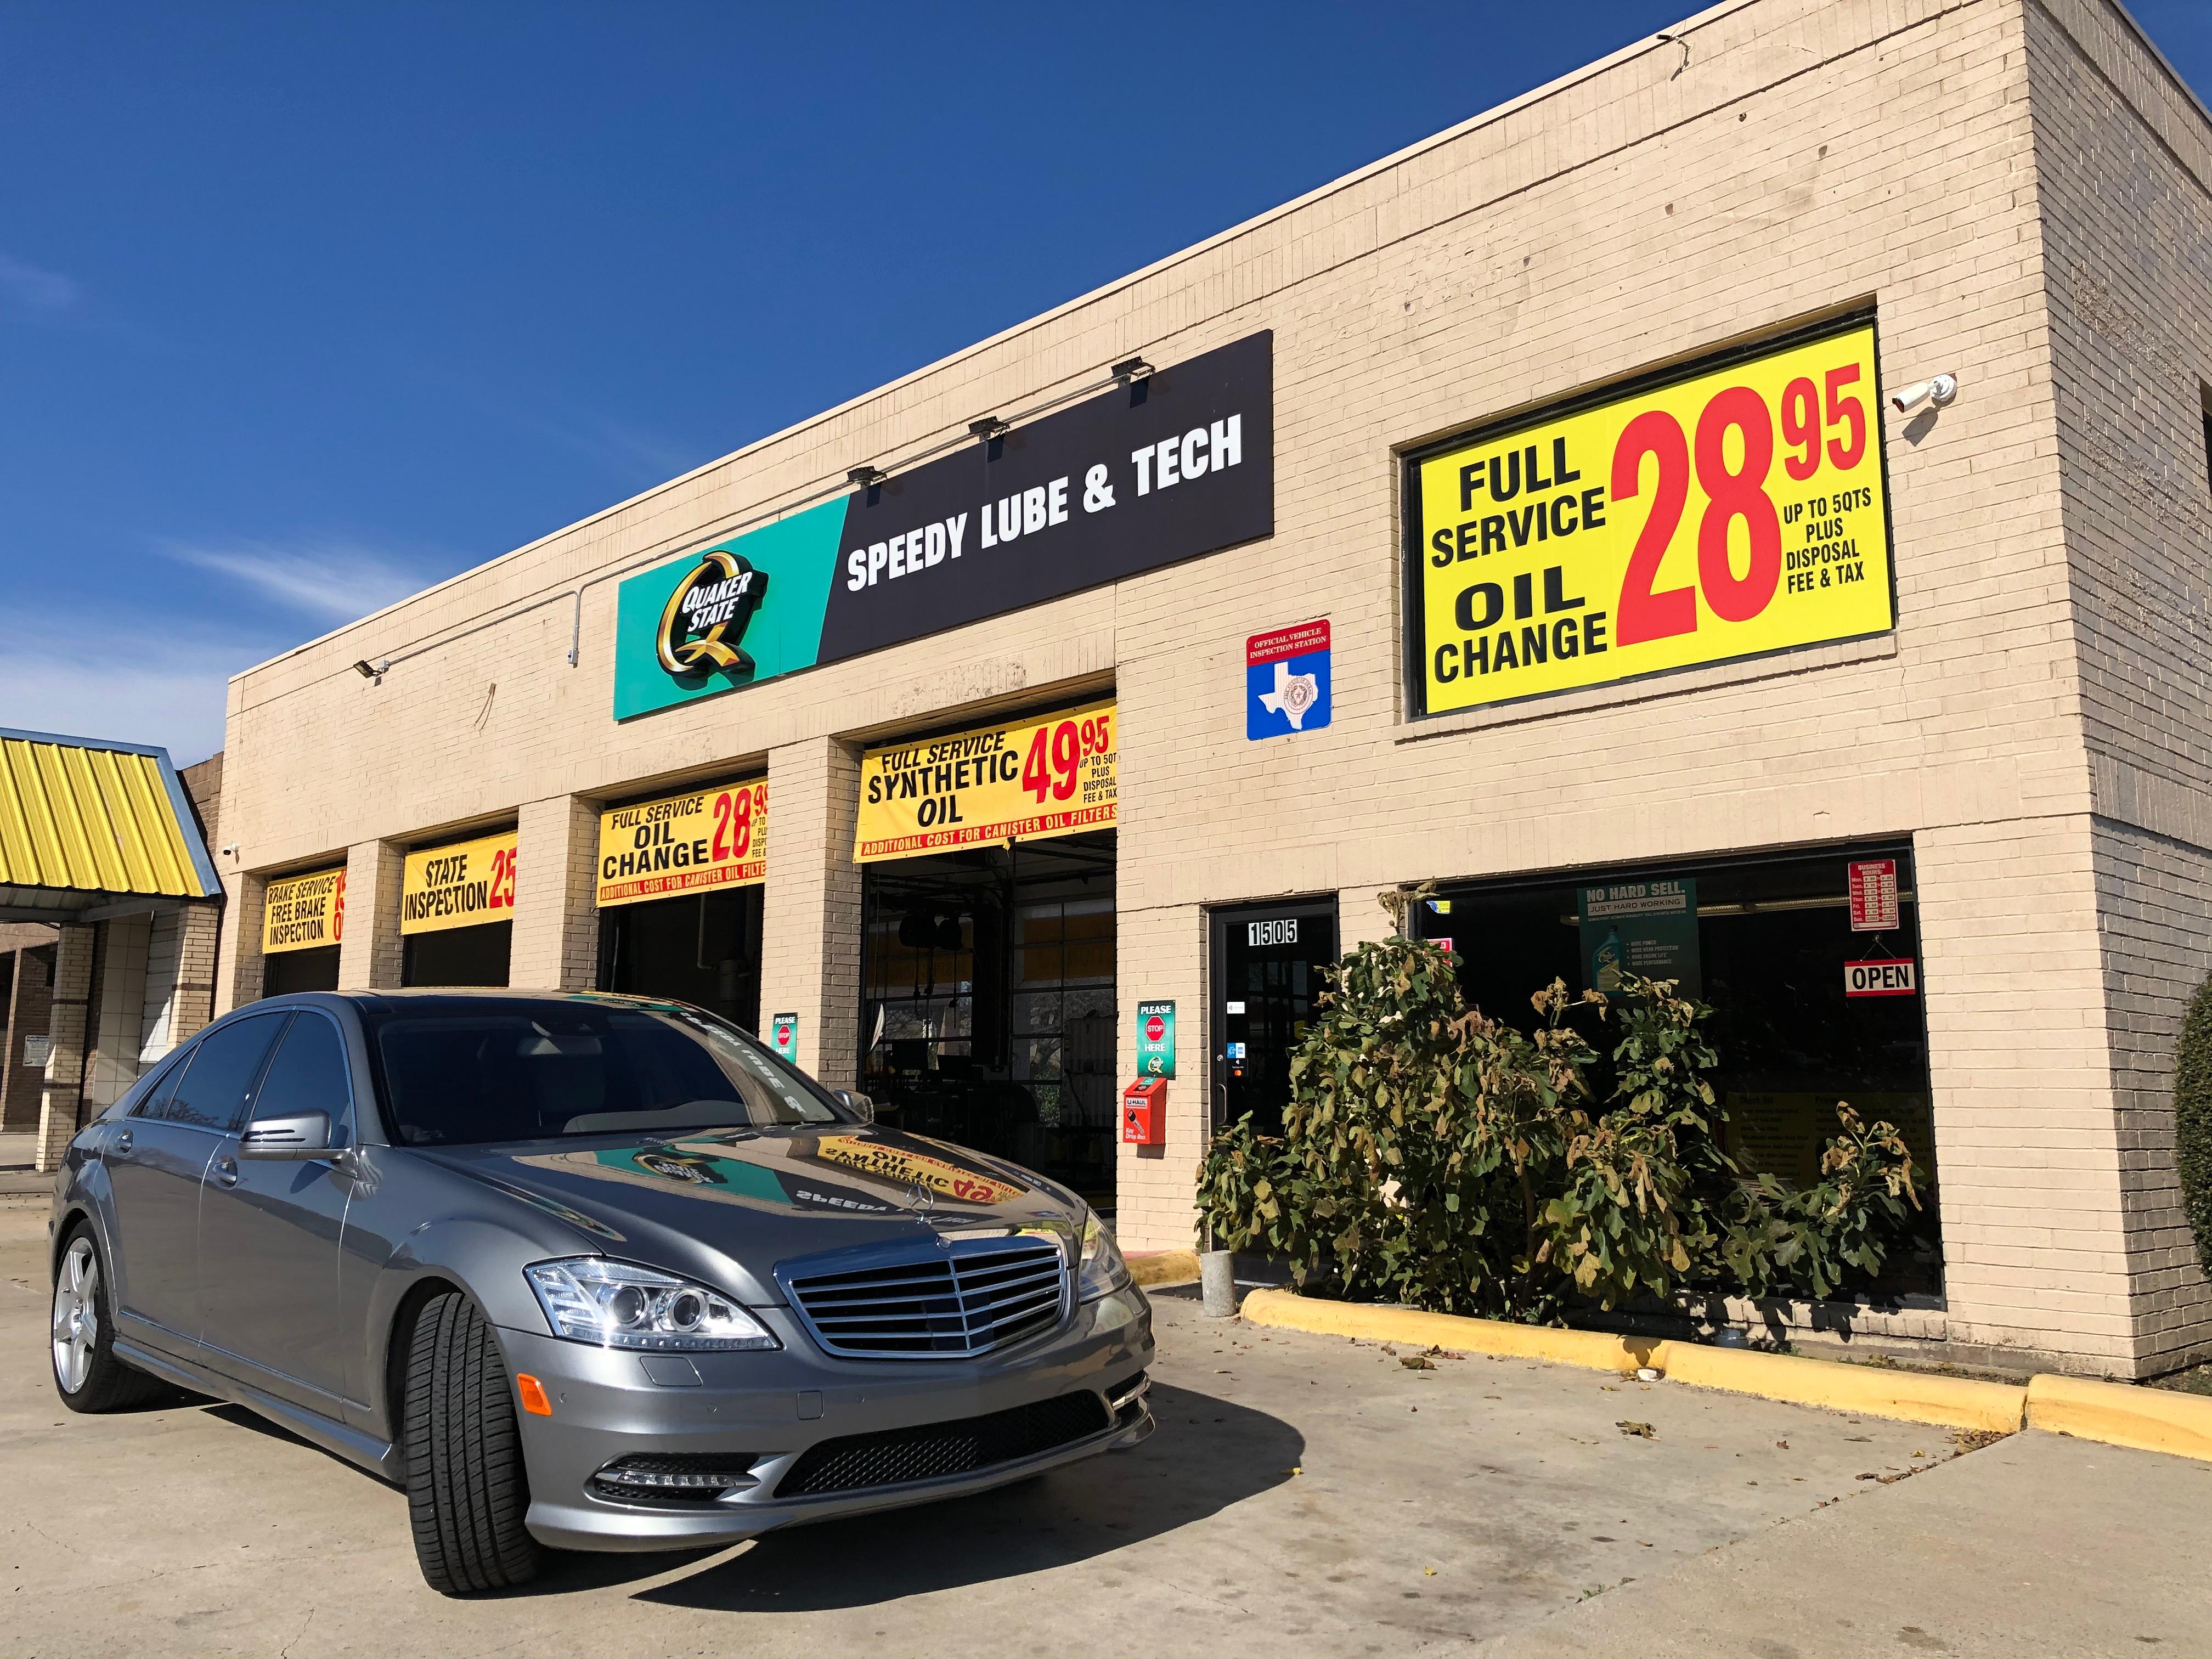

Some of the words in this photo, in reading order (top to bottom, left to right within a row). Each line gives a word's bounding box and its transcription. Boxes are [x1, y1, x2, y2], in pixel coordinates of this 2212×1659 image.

[1459, 436, 1580, 511] FULL
[847, 512, 967, 592] SPEEDY
[980, 476, 1068, 550] LUBE
[1082, 463, 1115, 514] &
[1131, 413, 1241, 498] TECH
[1611, 386, 1782, 647] 28
[1781, 362, 1866, 481] 95
[1784, 504, 1802, 524] UP
[1807, 498, 1827, 518] TO
[1833, 487, 1871, 514] 5QTS
[1431, 486, 1606, 568] SERVICE
[1806, 517, 1843, 543] PLUS
[1786, 538, 1860, 571] DISPOSAL
[682, 572, 752, 613] QUAKER
[1788, 571, 1815, 594] FEE
[1819, 568, 1831, 589] &
[1836, 561, 1864, 585] TAX
[687, 597, 739, 632] STATE
[1454, 566, 1585, 631] OIL
[1250, 644, 1293, 658] INSPECTION
[1295, 635, 1327, 650] STATION
[1254, 635, 1288, 649] OFFICIAL
[1289, 627, 1321, 641] VEHICLE
[1435, 612, 1607, 684] CHANGE
[882, 749, 921, 773] FULL
[930, 731, 1006, 764] SERVICE
[1022, 721, 1080, 804] 49
[1081, 715, 1110, 757] 95
[1079, 758, 1088, 769] UP
[1091, 756, 1102, 766] TO
[868, 751, 1018, 804] SYNTHETIC
[1084, 778, 1117, 792] DISPOSAL
[1092, 766, 1109, 778] PLUS
[917, 795, 963, 827] OIL
[1084, 792, 1096, 804] FEE
[1098, 791, 1103, 801] &
[1105, 788, 1117, 799] TAX
[612, 814, 641, 830] FULL
[646, 796, 704, 823] SERVICE
[713, 788, 751, 862] 28
[758, 816, 765, 826] TO
[634, 821, 675, 849] OIL
[864, 836, 922, 855] ADDITIONAL
[927, 831, 953, 845] COST
[958, 828, 980, 842] FOR
[985, 820, 1041, 838] CANISTER
[1046, 814, 1065, 830] OIL
[1070, 806, 1117, 825] FILTERS
[603, 839, 709, 879] CHANGE
[752, 849, 761, 858] FEE
[269, 885, 294, 905] BRAKE
[296, 875, 336, 899] SERVICE
[426, 854, 467, 888] STATE
[489, 847, 517, 910] 25
[601, 882, 642, 900] ADDITIONAL
[644, 879, 663, 894] COST
[667, 877, 682, 890] FOR
[685, 870, 722, 886] CANISTER
[725, 867, 740, 880] OIL
[1587, 888, 1605, 902] NO
[1609, 885, 1646, 900] HARD
[1651, 881, 1685, 896] SELL.
[271, 904, 292, 924] FREE
[295, 896, 326, 921] BRAKE
[404, 881, 488, 921] INSPECTION
[1590, 905, 1611, 913] JUST
[1640, 899, 1683, 908] WORKING.
[270, 919, 324, 946] INSPECTION
[1251, 920, 1296, 945] 1505
[1852, 964, 1909, 990] OPEN
[1141, 1005, 1172, 1015] PLEASE
[1147, 1024, 1164, 1032] STOP
[1144, 1043, 1166, 1052] HERE
[1125, 1133, 1137, 1141] Drop
